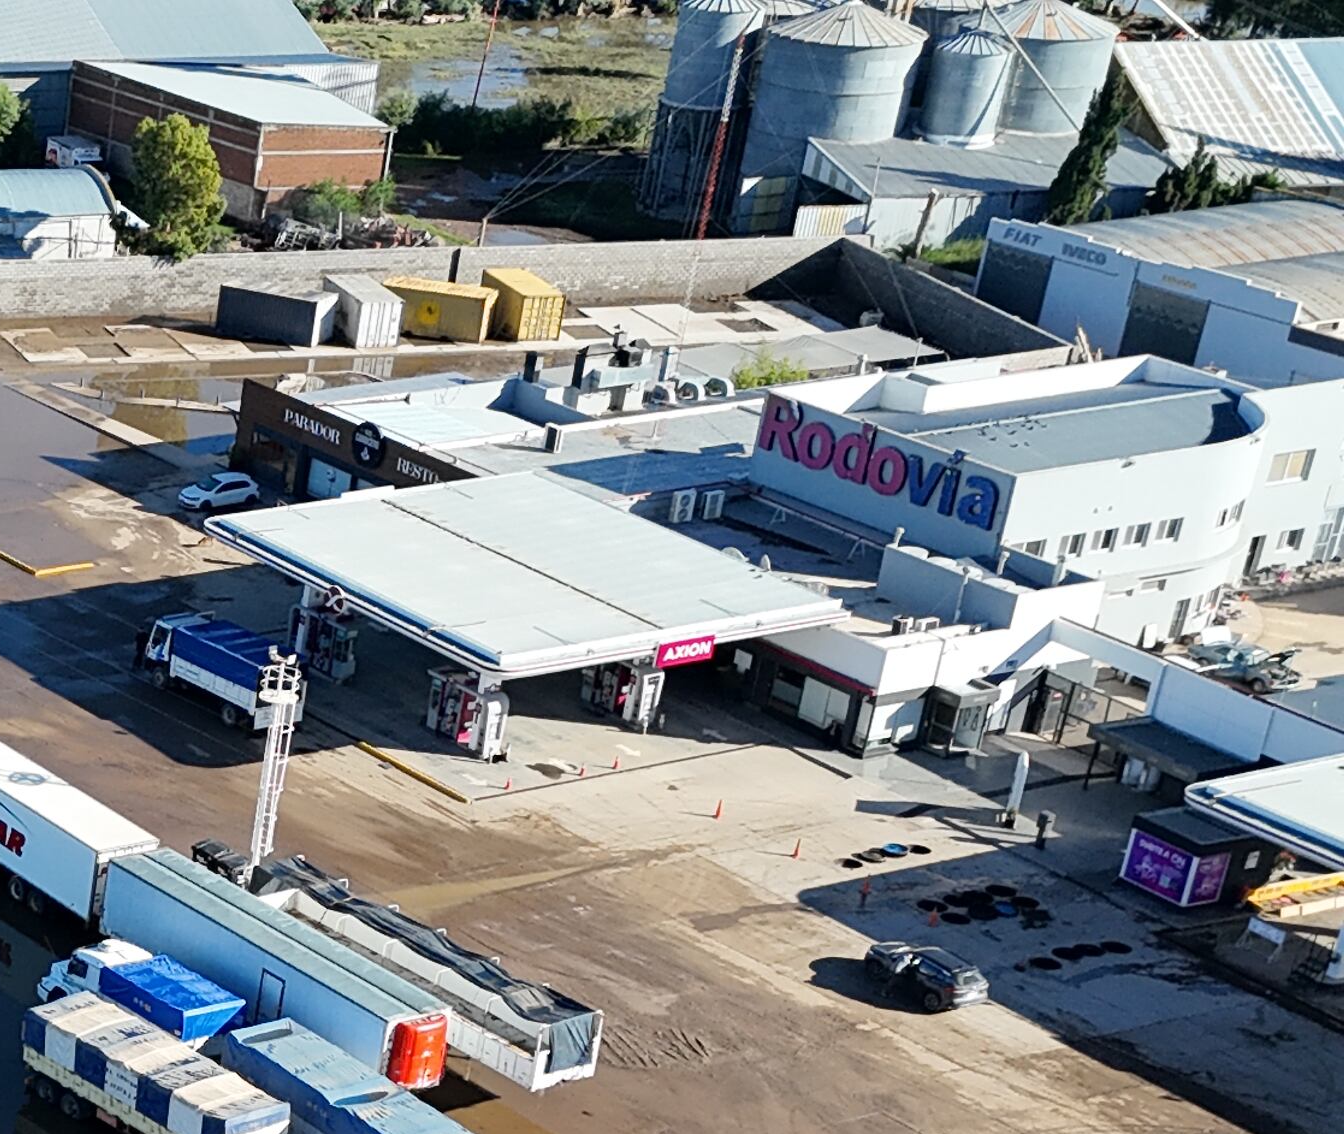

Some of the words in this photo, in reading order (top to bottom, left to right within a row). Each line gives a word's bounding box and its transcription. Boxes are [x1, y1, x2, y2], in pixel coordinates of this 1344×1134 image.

[1003, 228, 1042, 247] FIAT
[1062, 243, 1107, 266] IVECO
[284, 408, 341, 445] PARADOR
[759, 394, 1000, 531] Rodovía
[663, 640, 712, 662] AXION
